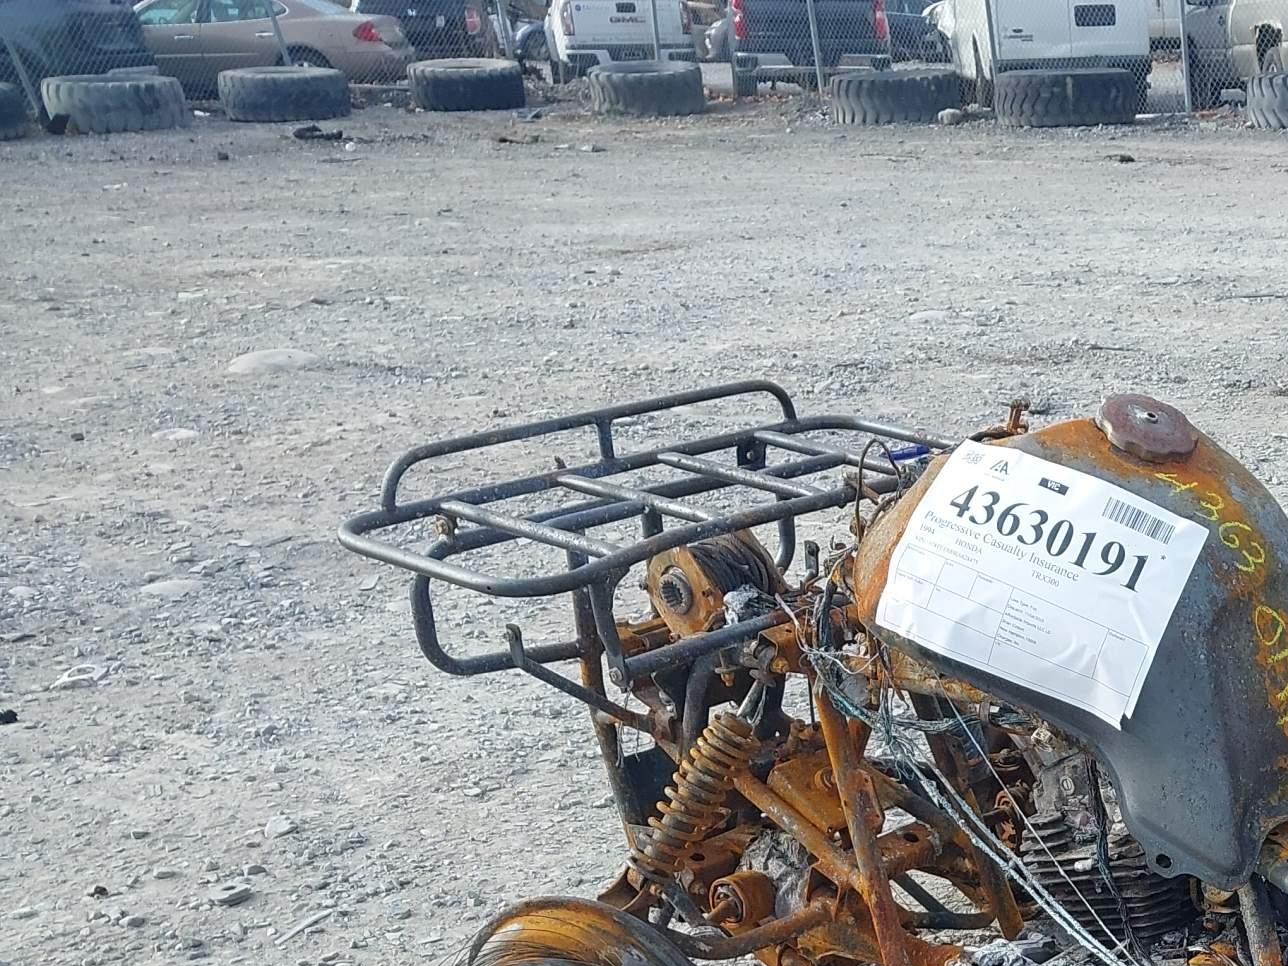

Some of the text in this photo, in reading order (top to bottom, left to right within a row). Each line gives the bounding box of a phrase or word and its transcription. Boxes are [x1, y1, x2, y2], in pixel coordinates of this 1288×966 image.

[609, 15, 646, 23] GMC
[1047, 480, 1061, 491] VIC
[919, 522, 936, 535] 1994
[924, 509, 981, 541] Progressive
[982, 532, 1027, 562] Casualty
[1028, 551, 1080, 582] Insurance
[950, 484, 1149, 593] 43630191
[954, 538, 983, 556] HONDA
[1031, 569, 1060, 588] TRX300
